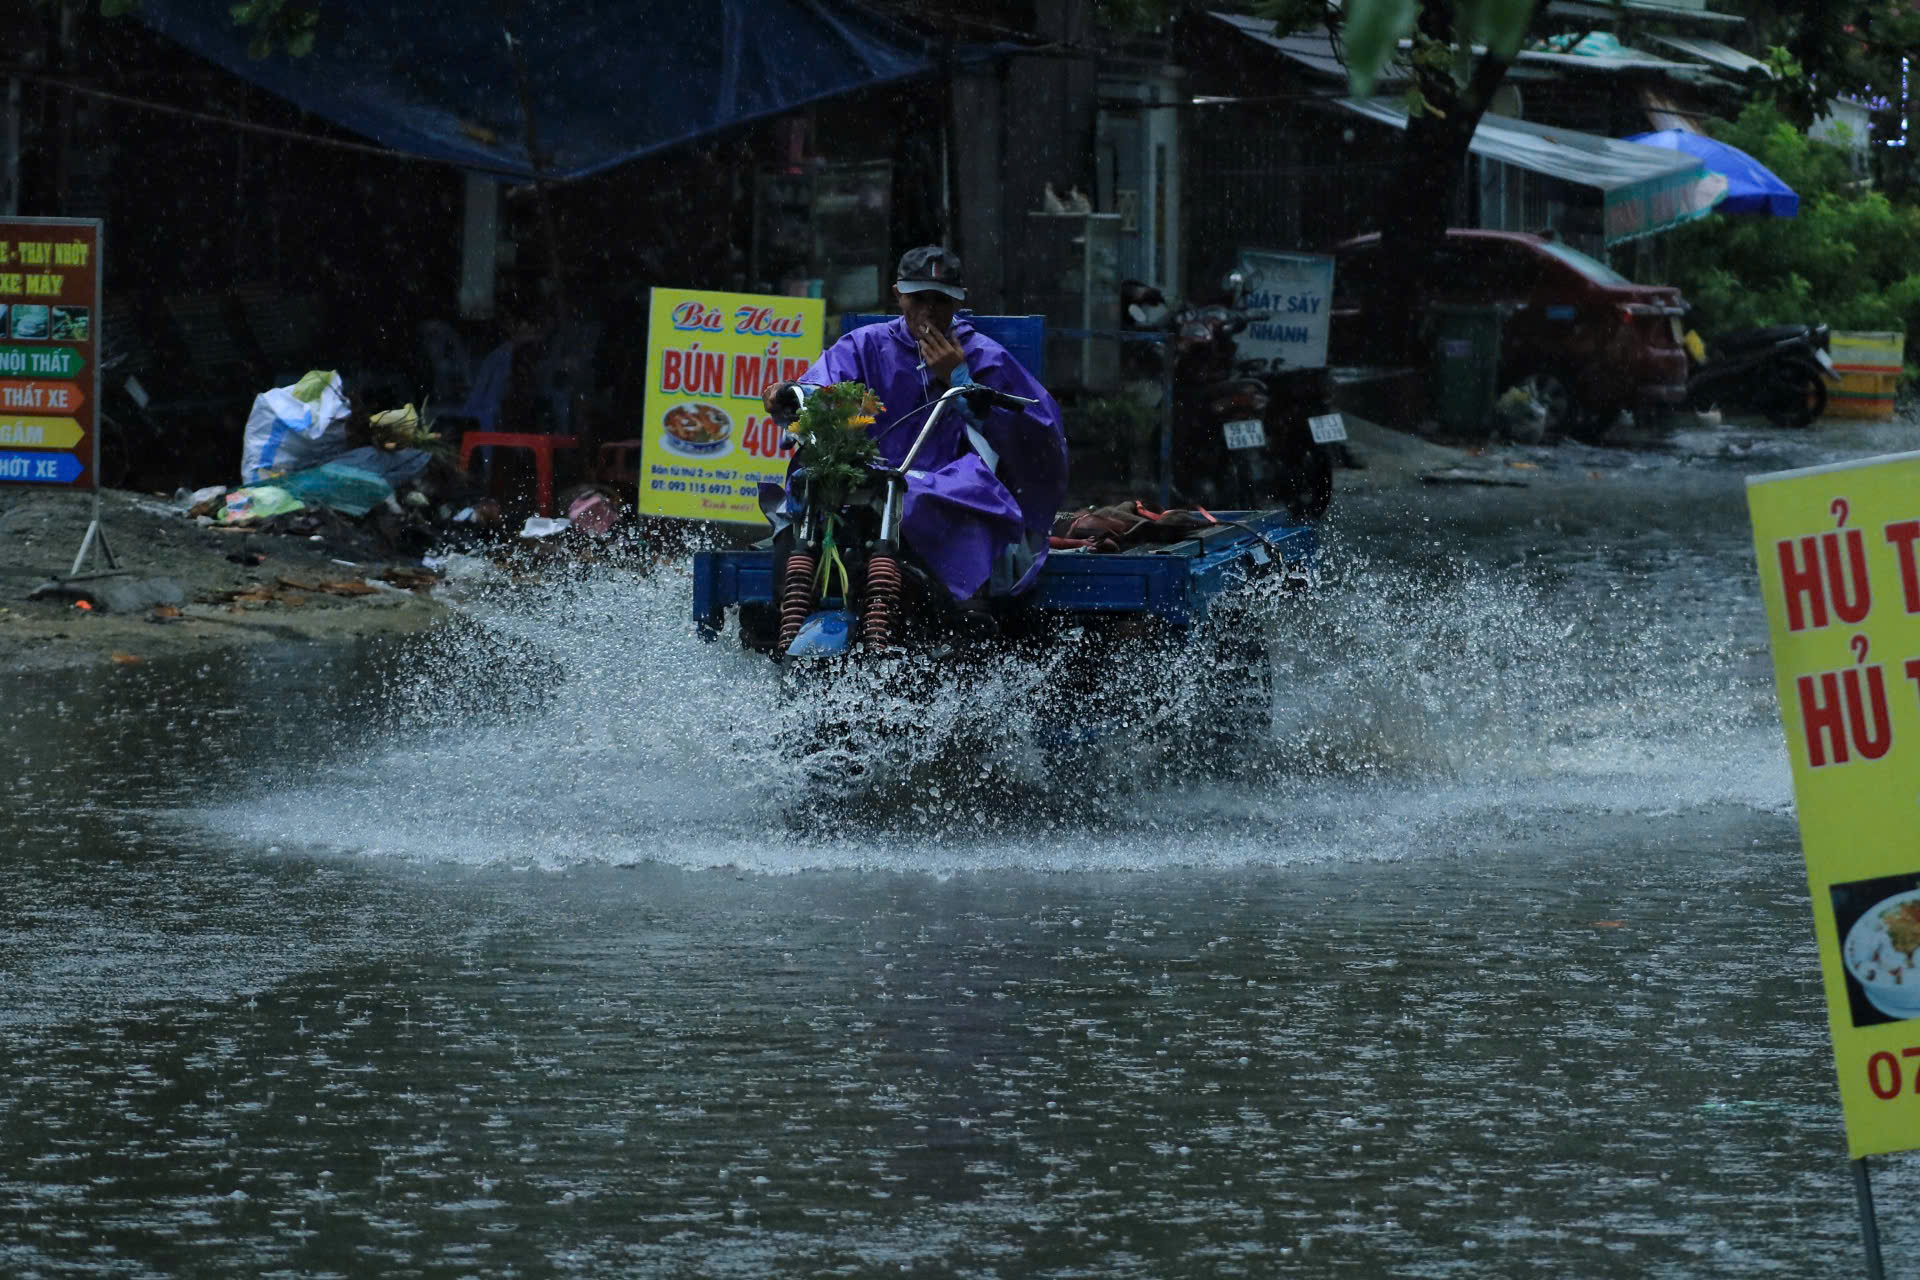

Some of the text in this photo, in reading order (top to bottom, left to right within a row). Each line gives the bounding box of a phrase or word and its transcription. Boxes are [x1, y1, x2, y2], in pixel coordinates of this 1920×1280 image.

[18, 242, 52, 264] THAY
[1287, 291, 1320, 313] SẤY
[672, 301, 803, 336] Bà Hai
[1248, 324, 1309, 344] NHANH
[0, 348, 70, 375] NỘI THẤT
[661, 343, 725, 396] BÚN
[2, 382, 69, 408] THẤT XE
[36, 460, 57, 478] XE
[697, 468, 703, 477] 2
[732, 471, 738, 480] 7
[668, 481, 686, 492] 093
[689, 482, 706, 493] 115
[708, 483, 732, 495] 6973
[1777, 498, 1872, 632] HỦ
[1796, 634, 1894, 768] HỦ
